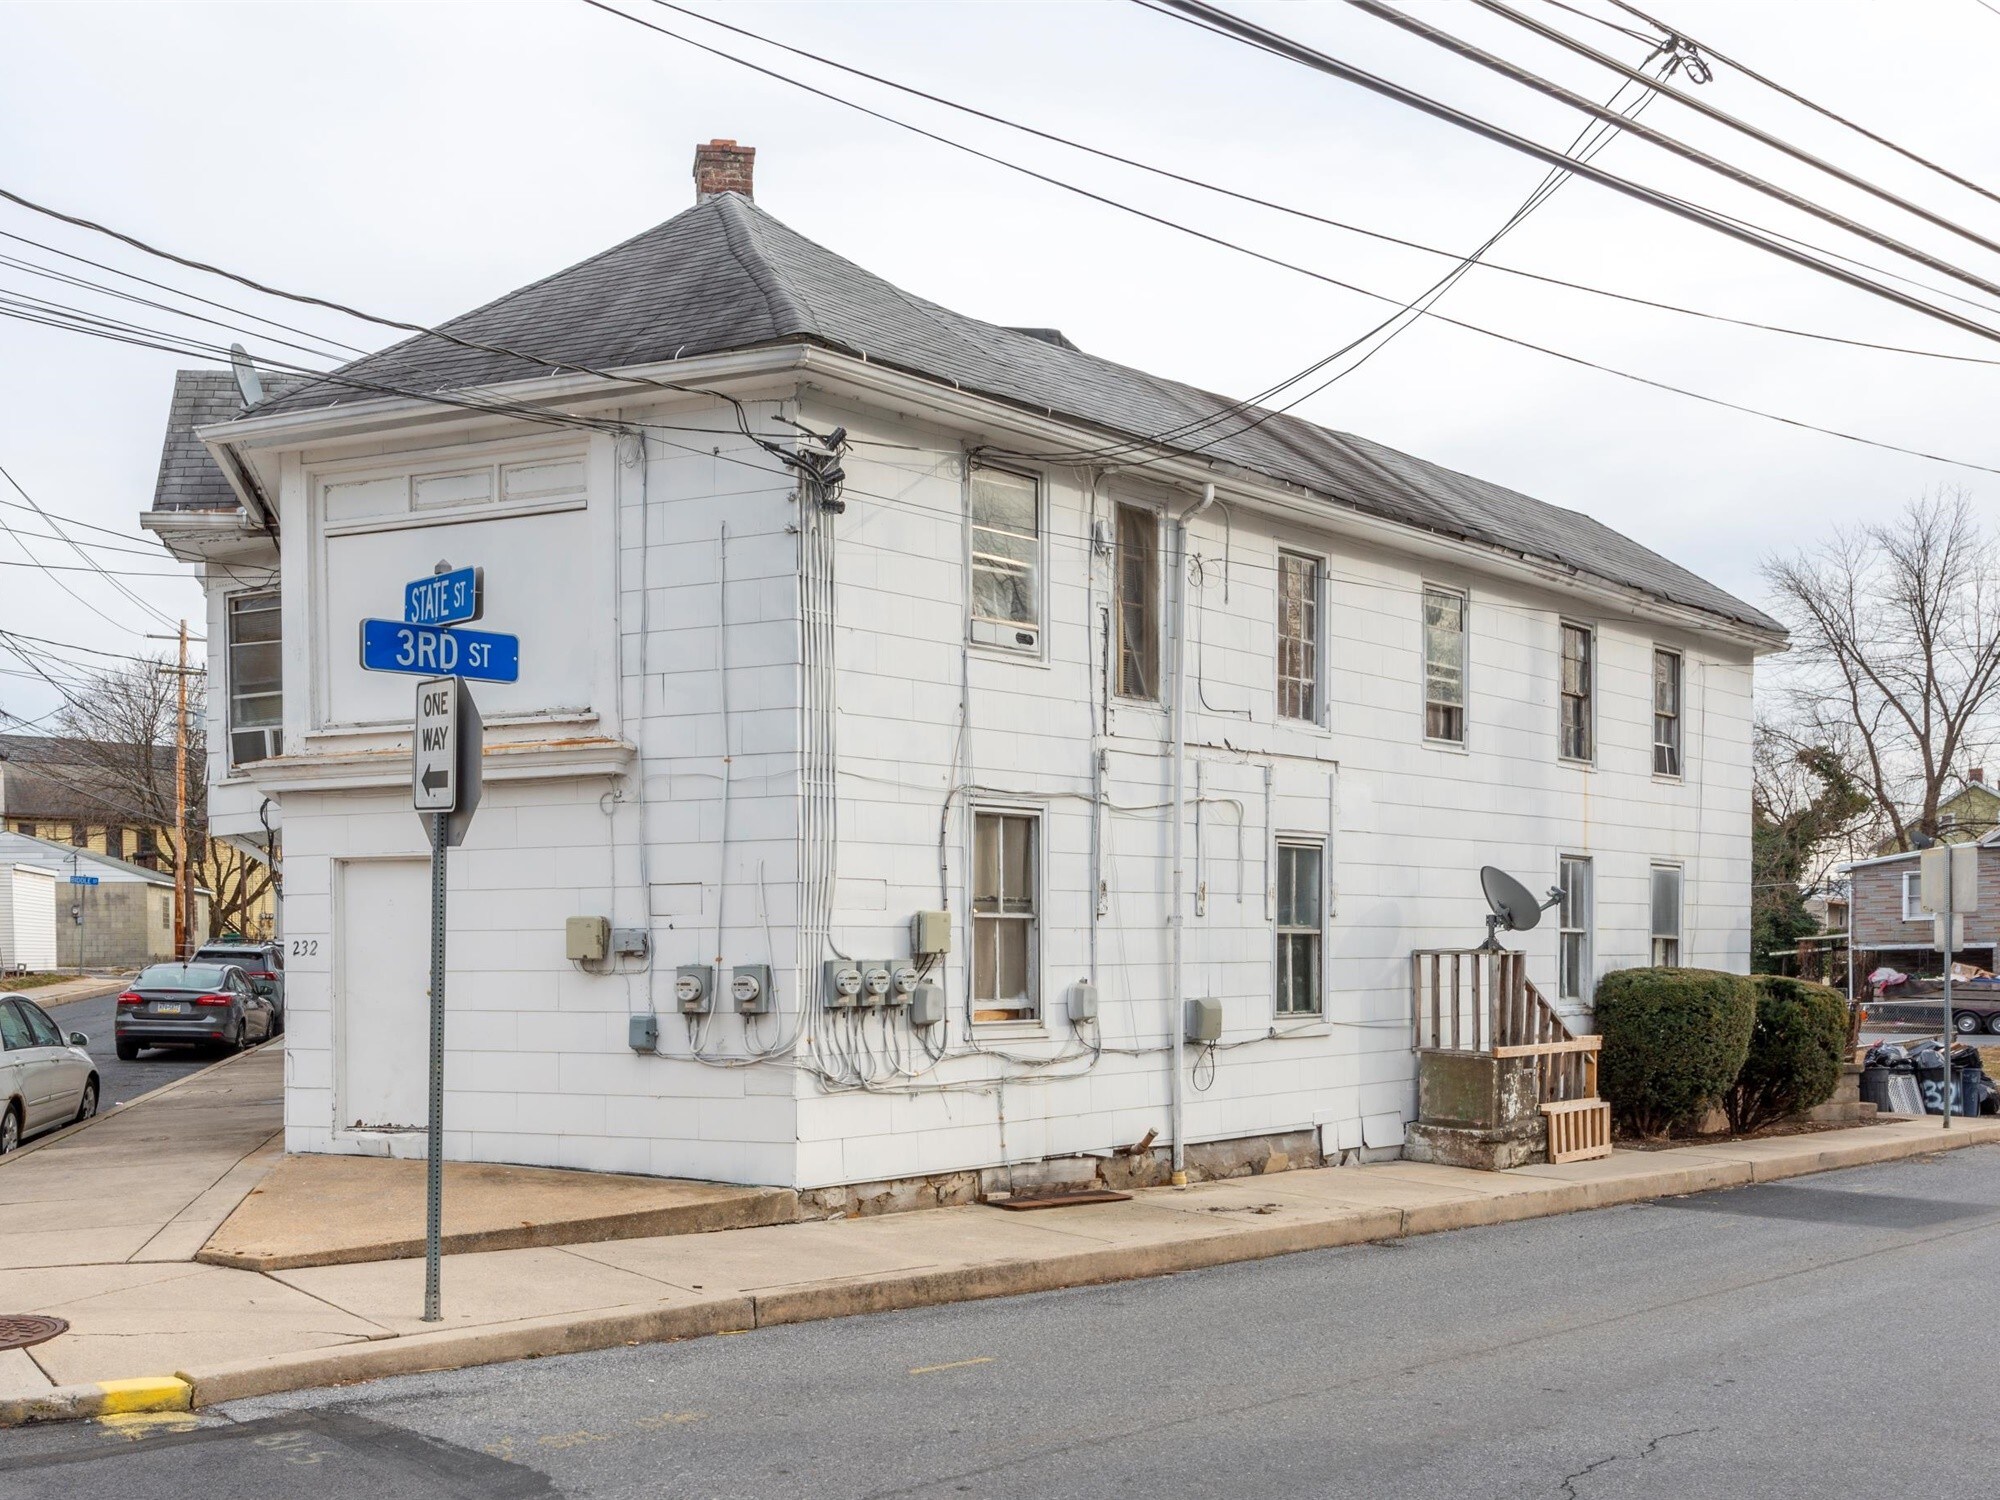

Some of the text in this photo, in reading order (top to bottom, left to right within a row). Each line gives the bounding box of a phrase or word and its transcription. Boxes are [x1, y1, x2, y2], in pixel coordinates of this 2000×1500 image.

[411, 579, 466, 623] STATE ST
[396, 629, 492, 670] 3RD ST
[423, 691, 449, 717] ONE
[422, 725, 449, 752] WAY
[293, 940, 318, 956] 232
